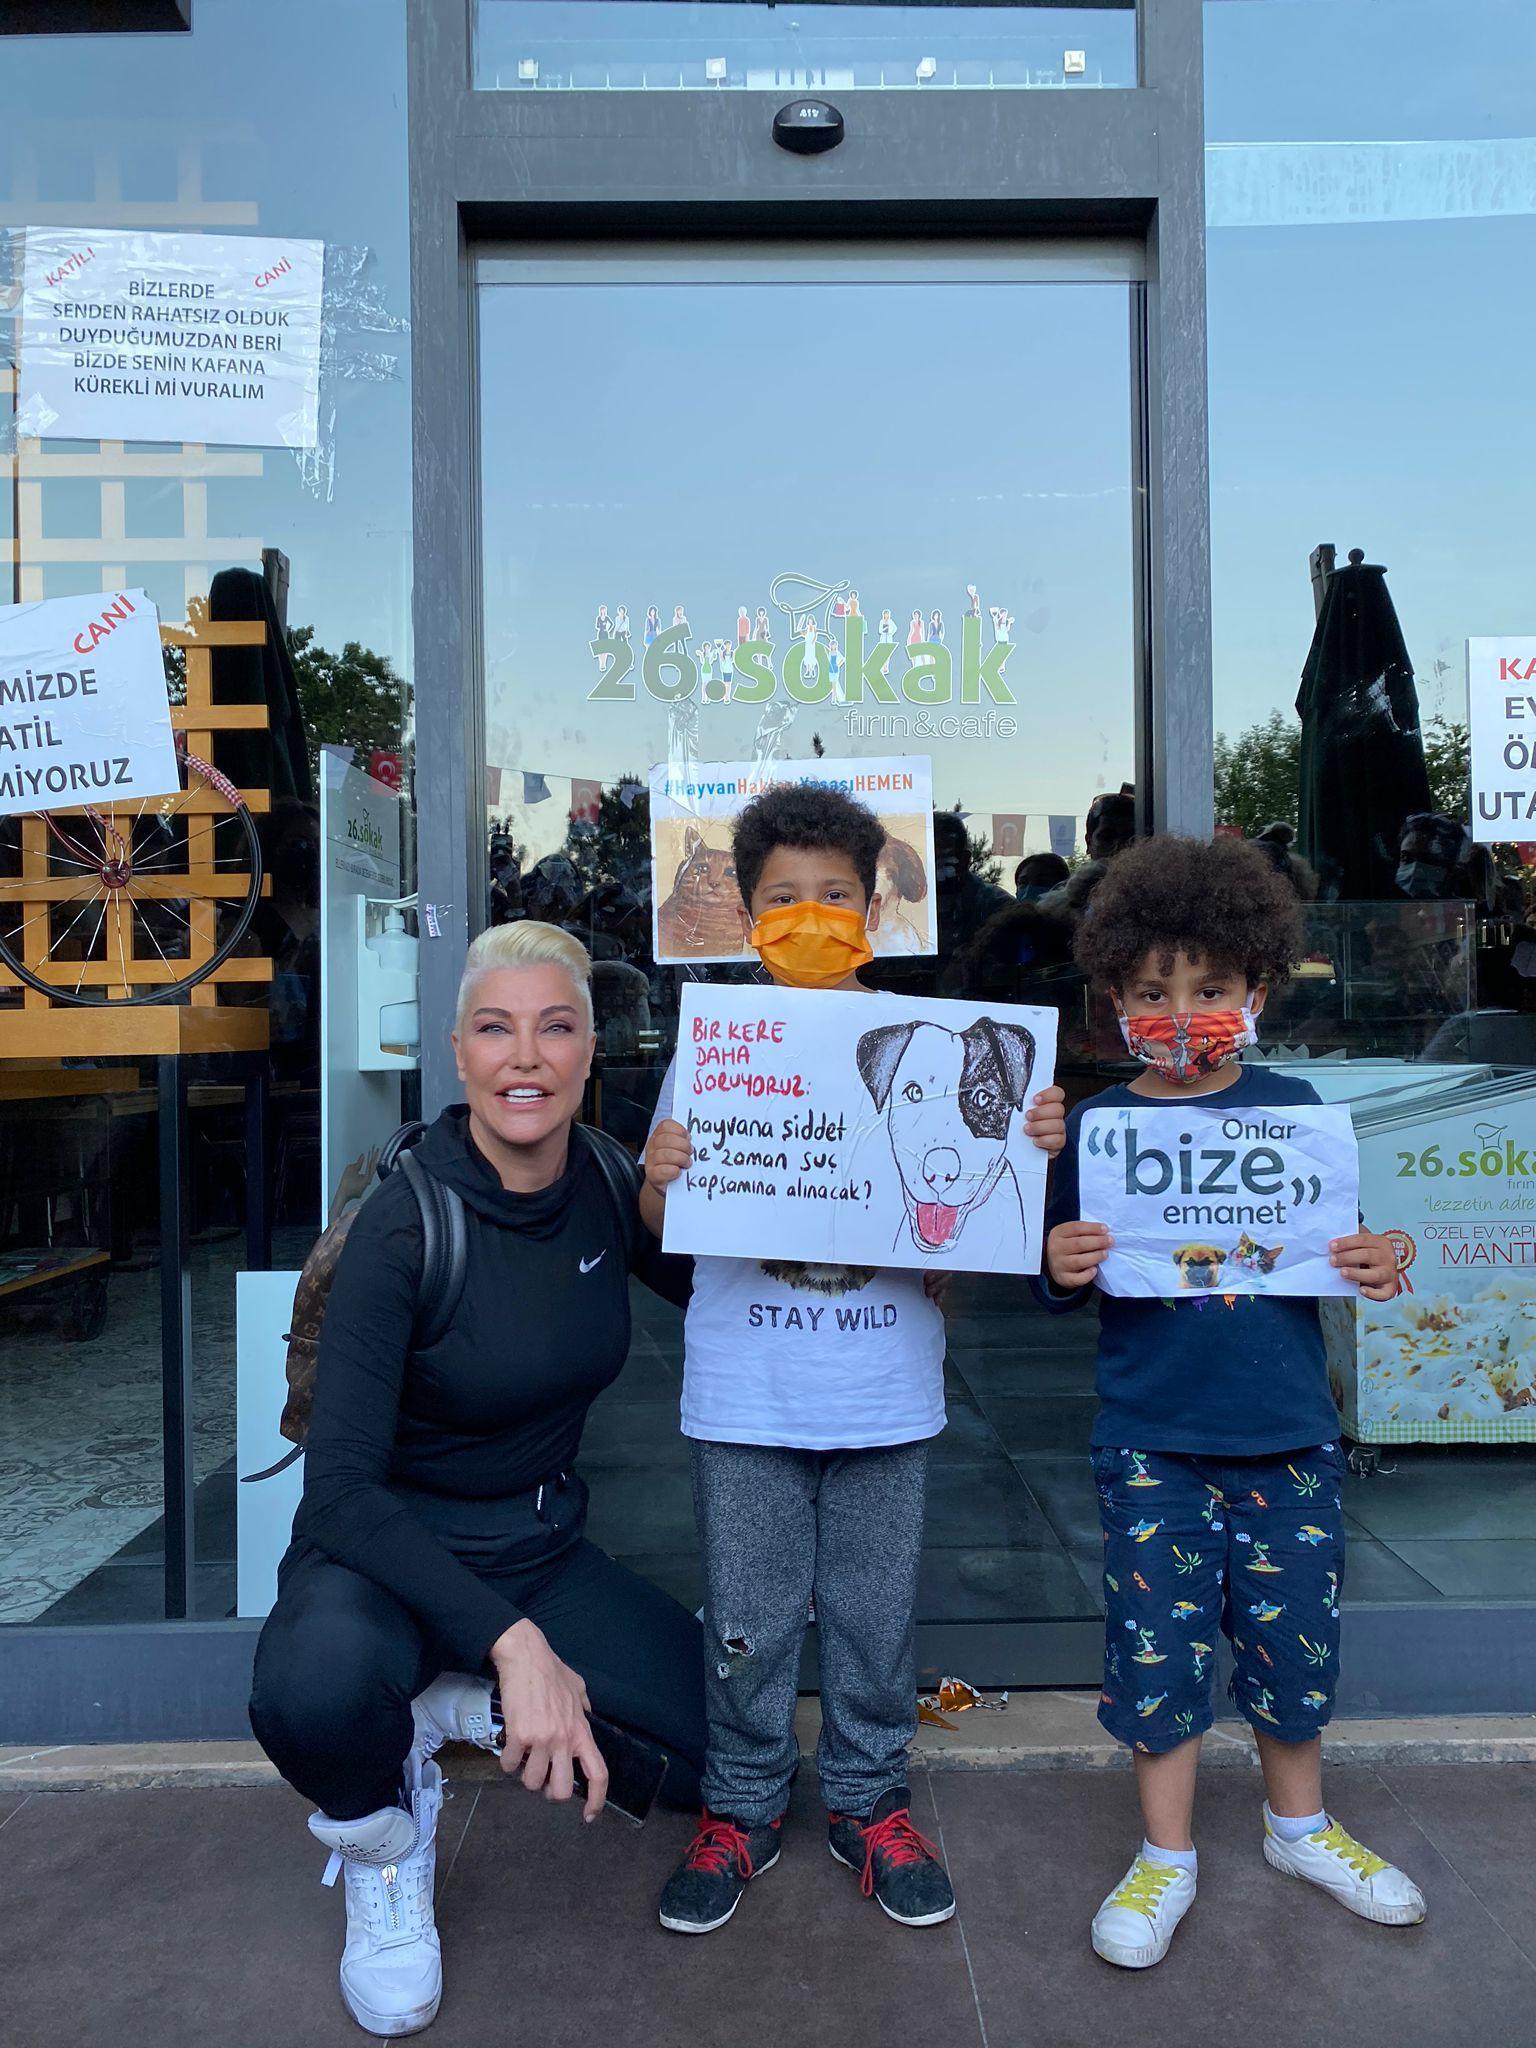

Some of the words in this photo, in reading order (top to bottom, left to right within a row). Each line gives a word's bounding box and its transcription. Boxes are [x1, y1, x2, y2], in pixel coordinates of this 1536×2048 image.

[254, 255, 292, 289] CANİ
[128, 279, 215, 300] BİZLERDE
[53, 303, 127, 320] SENDEN
[131, 306, 220, 324] RAHATSIZ
[225, 309, 290, 327] OLDUK
[59, 327, 237, 350] DUYDUĞUMUZDAN
[243, 333, 282, 351] BERİ
[74, 352, 127, 370] BİZDE
[132, 354, 187, 372] SENİN
[191, 356, 265, 375] KAFANA
[74, 376, 150, 396] KÜREKLİ
[155, 379, 176, 397] Mİ
[181, 382, 264, 399] VURALIM
[73, 593, 136, 655] CANİ
[587, 613, 1018, 706] 26.sokak
[728, 1018, 787, 1044] KERE
[696, 1045, 750, 1067] DAHA
[687, 1107, 774, 1151] hayvana
[1222, 1118, 1297, 1140] Onlar
[721, 1148, 788, 1170] zaman
[800, 1151, 838, 1175] suç
[687, 1171, 776, 1201] kapsamına
[786, 1177, 872, 1211] alınacak?
[1163, 1200, 1287, 1225] emanet
[1424, 1224, 1469, 1240] ÖZEL
[1473, 1225, 1495, 1239] EV
[748, 1303, 825, 1331] STAY
[835, 1304, 898, 1331] WILD
